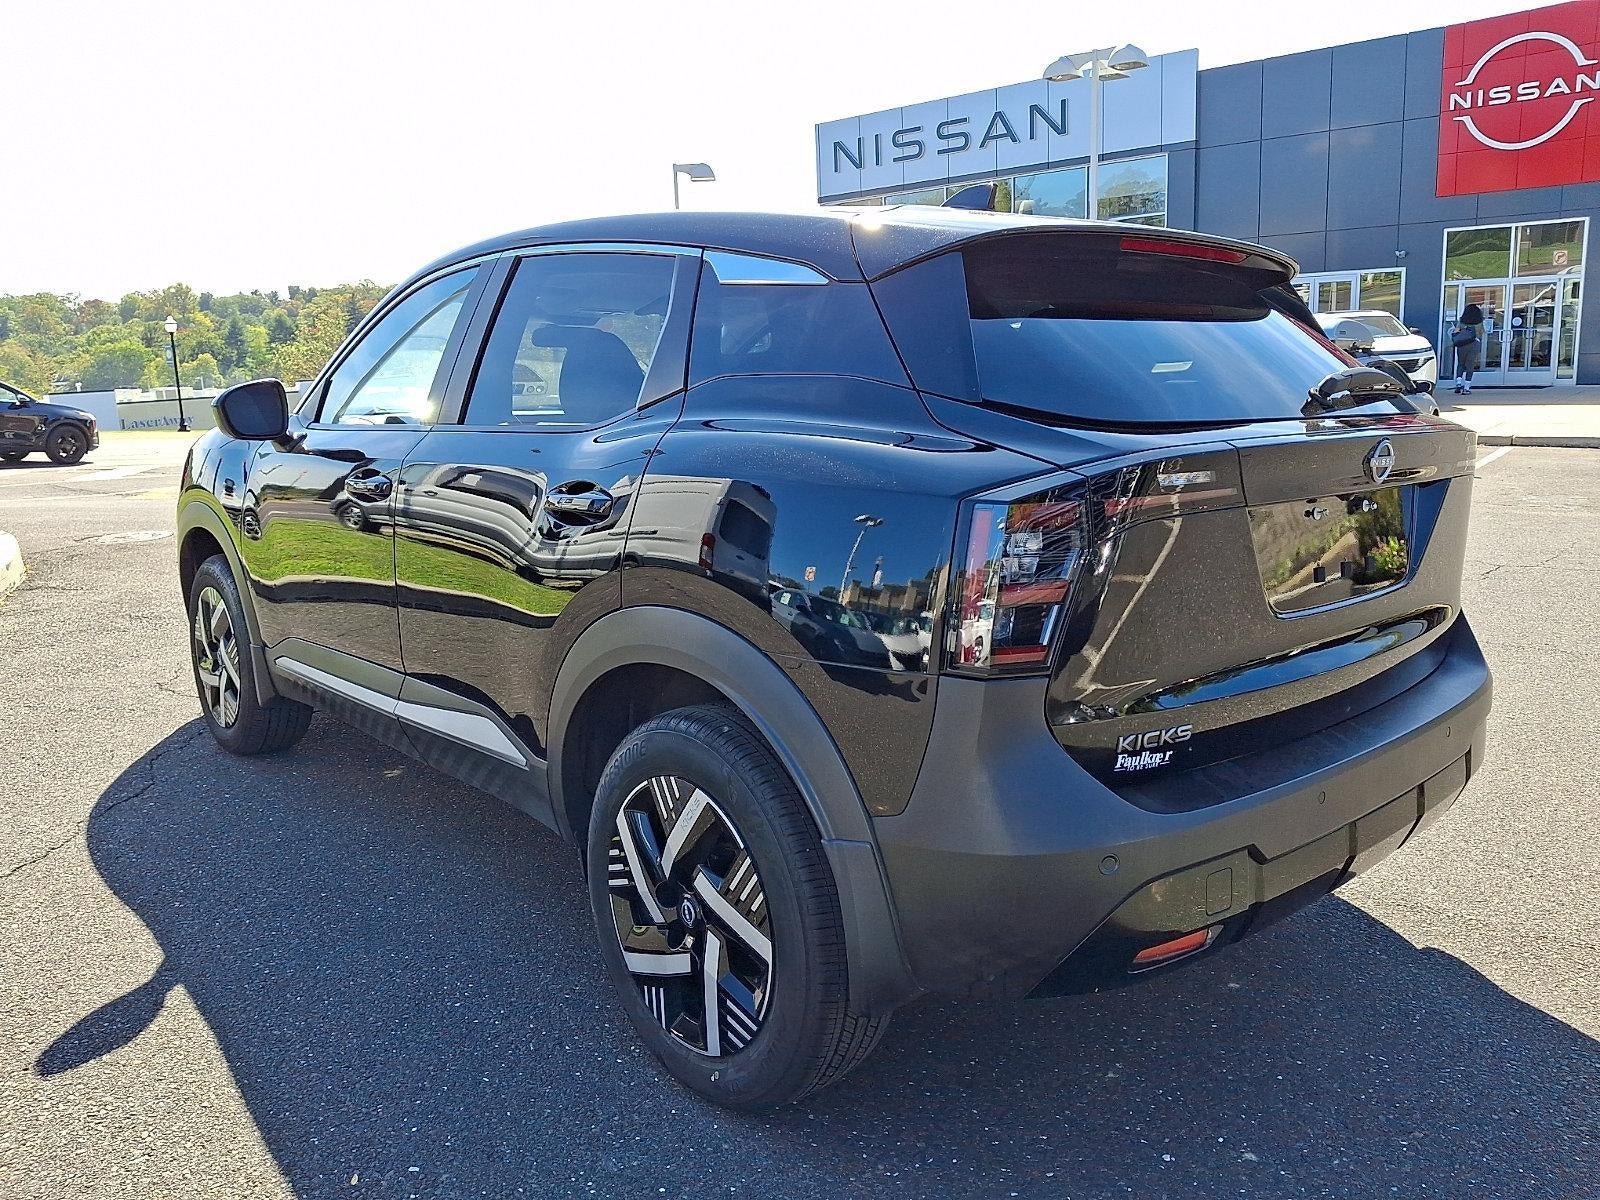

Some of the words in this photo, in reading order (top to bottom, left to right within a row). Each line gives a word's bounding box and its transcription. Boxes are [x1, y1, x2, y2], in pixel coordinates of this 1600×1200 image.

[1449, 70, 1600, 111] NISSAN
[832, 98, 1068, 173] NISSAN
[120, 416, 194, 430] LaserAwy
[1117, 724, 1193, 753] KICKS
